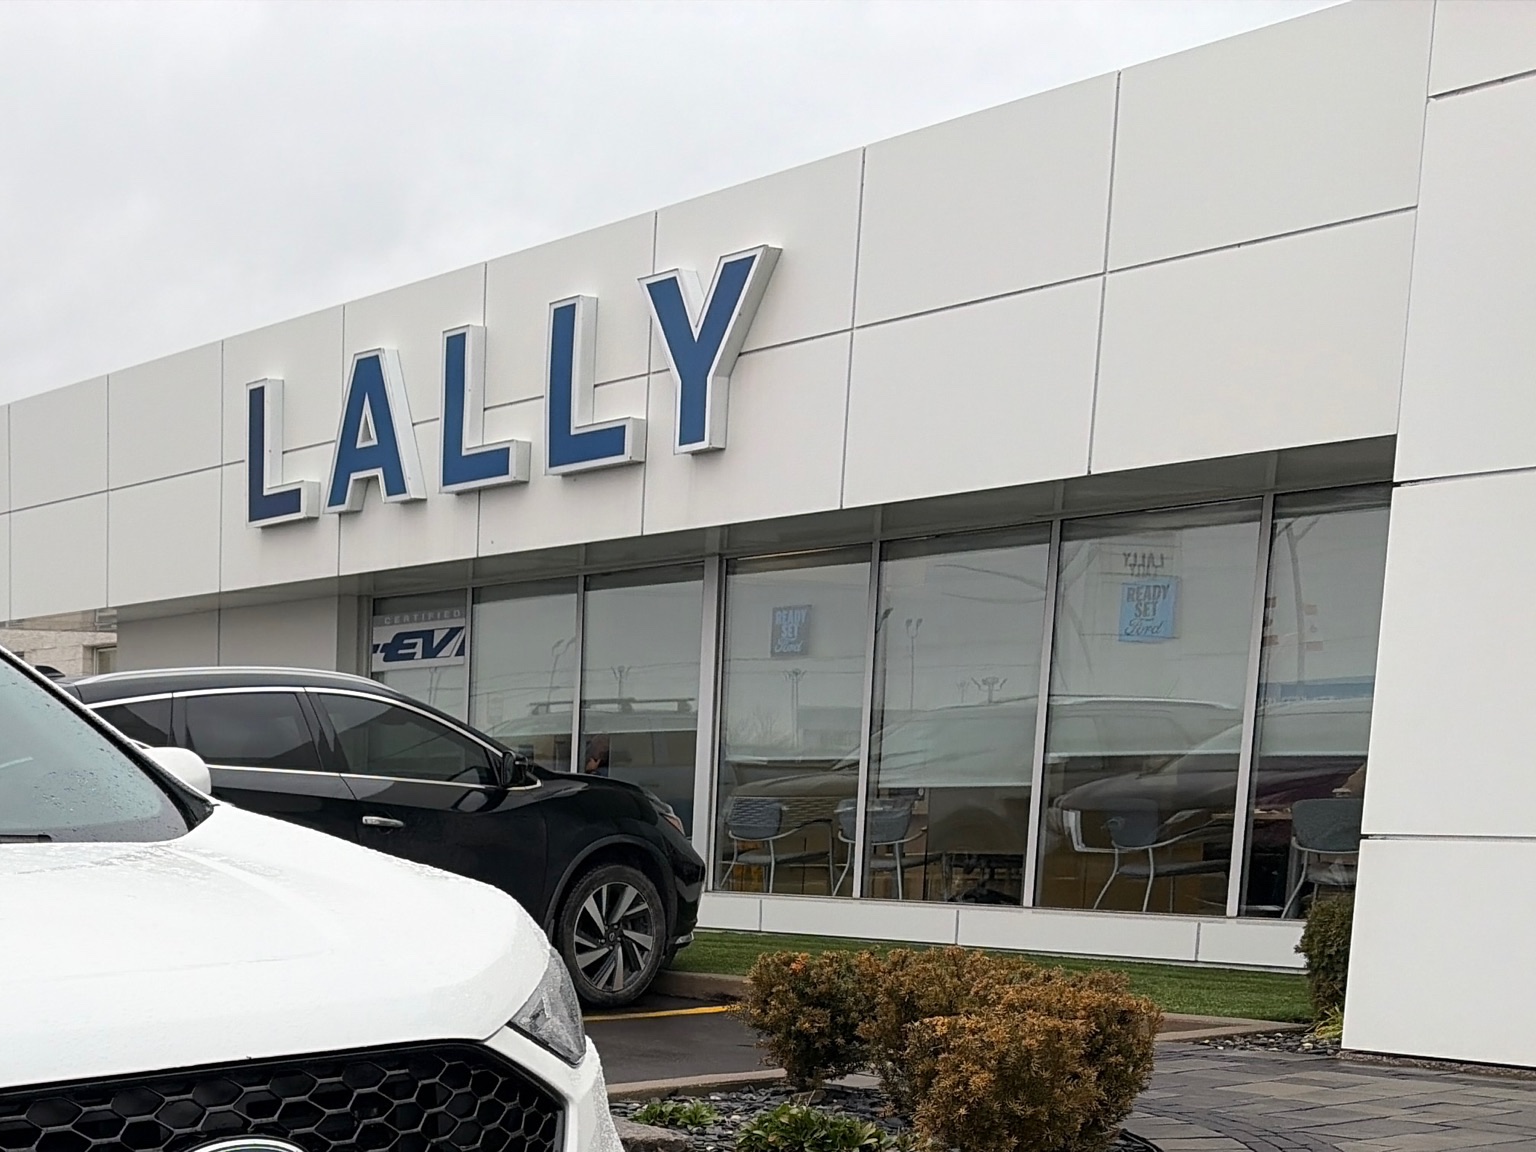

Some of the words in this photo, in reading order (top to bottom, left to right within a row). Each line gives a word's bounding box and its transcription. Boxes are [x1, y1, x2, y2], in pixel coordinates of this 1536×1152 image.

[245, 244, 778, 528] LALLY
[1126, 584, 1170, 602] READY
[384, 609, 461, 625] CERTIFIED
[775, 609, 808, 625] READY
[1134, 601, 1159, 618] SET
[781, 624, 798, 639] SET
[1124, 618, 1164, 636] Ford
[382, 626, 465, 662] EV
